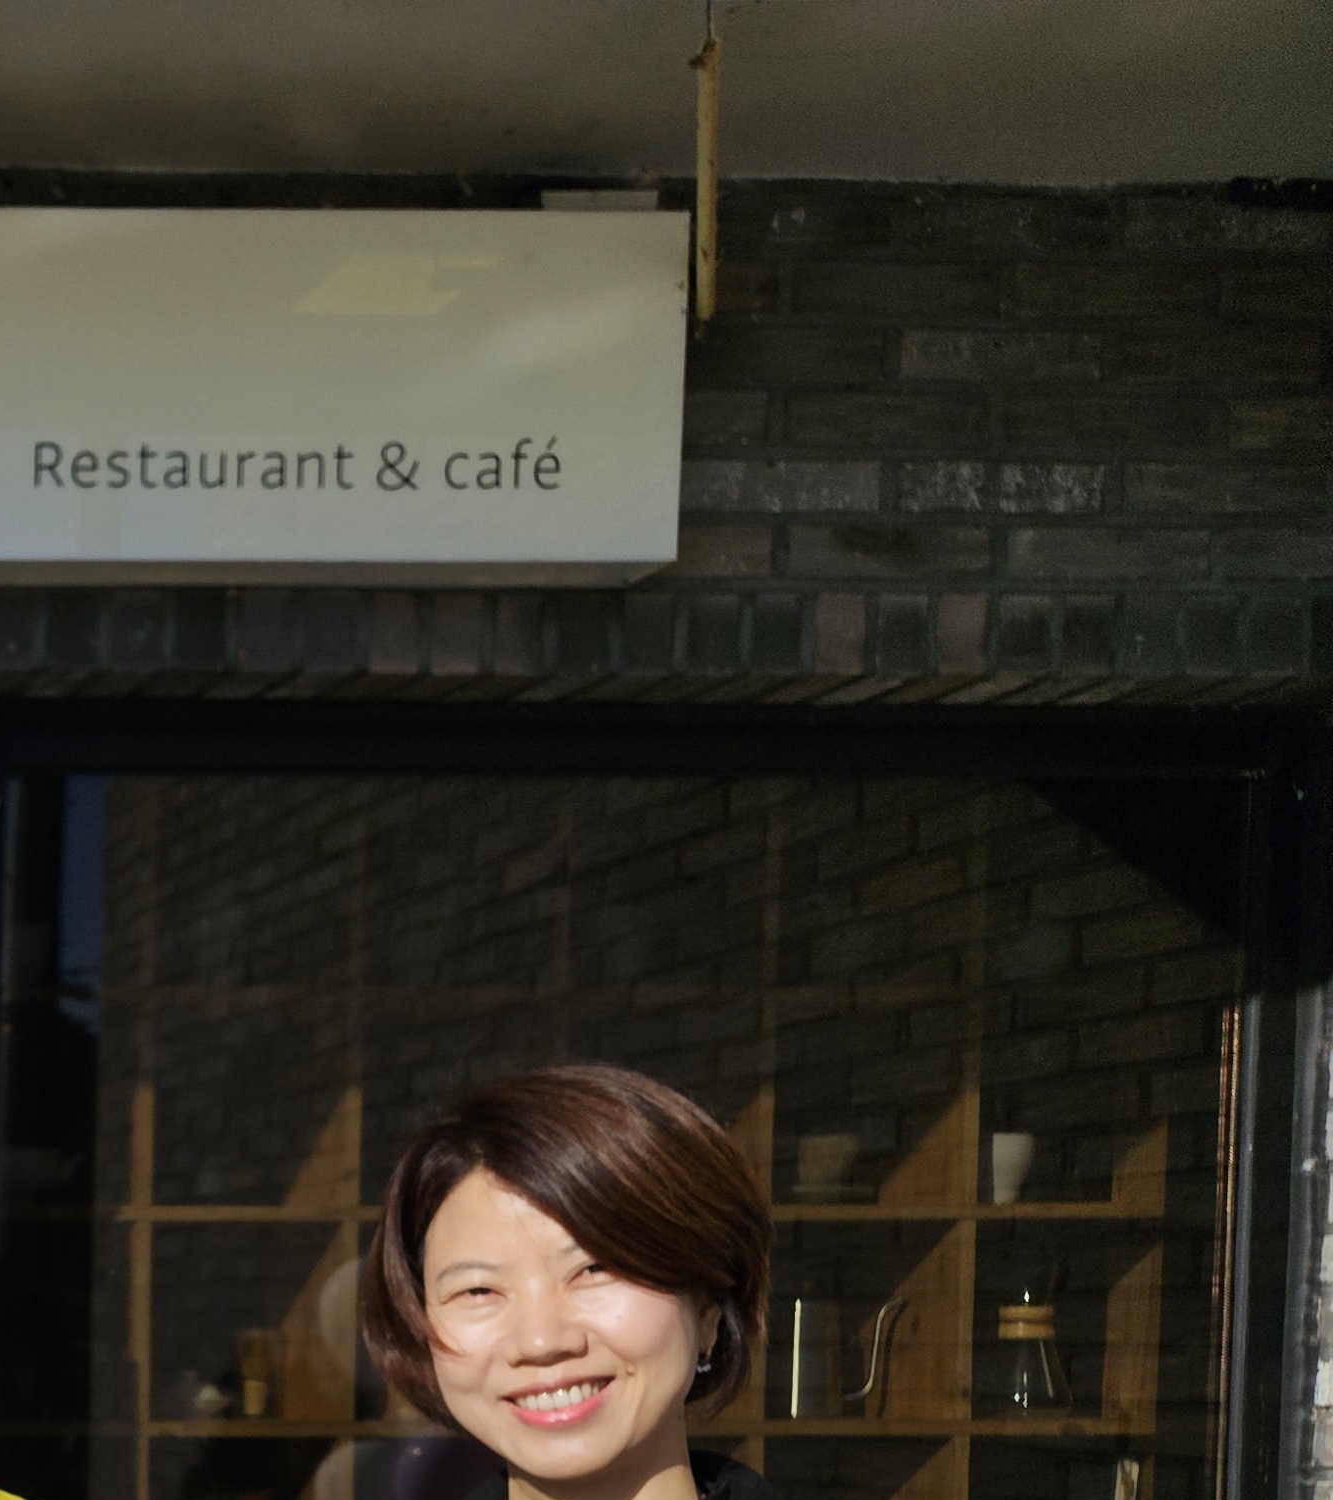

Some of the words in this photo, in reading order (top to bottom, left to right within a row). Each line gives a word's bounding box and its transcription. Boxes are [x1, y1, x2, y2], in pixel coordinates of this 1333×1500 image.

[32, 440, 355, 491] Restaurant
[375, 440, 420, 492] &
[443, 436, 562, 491] café
